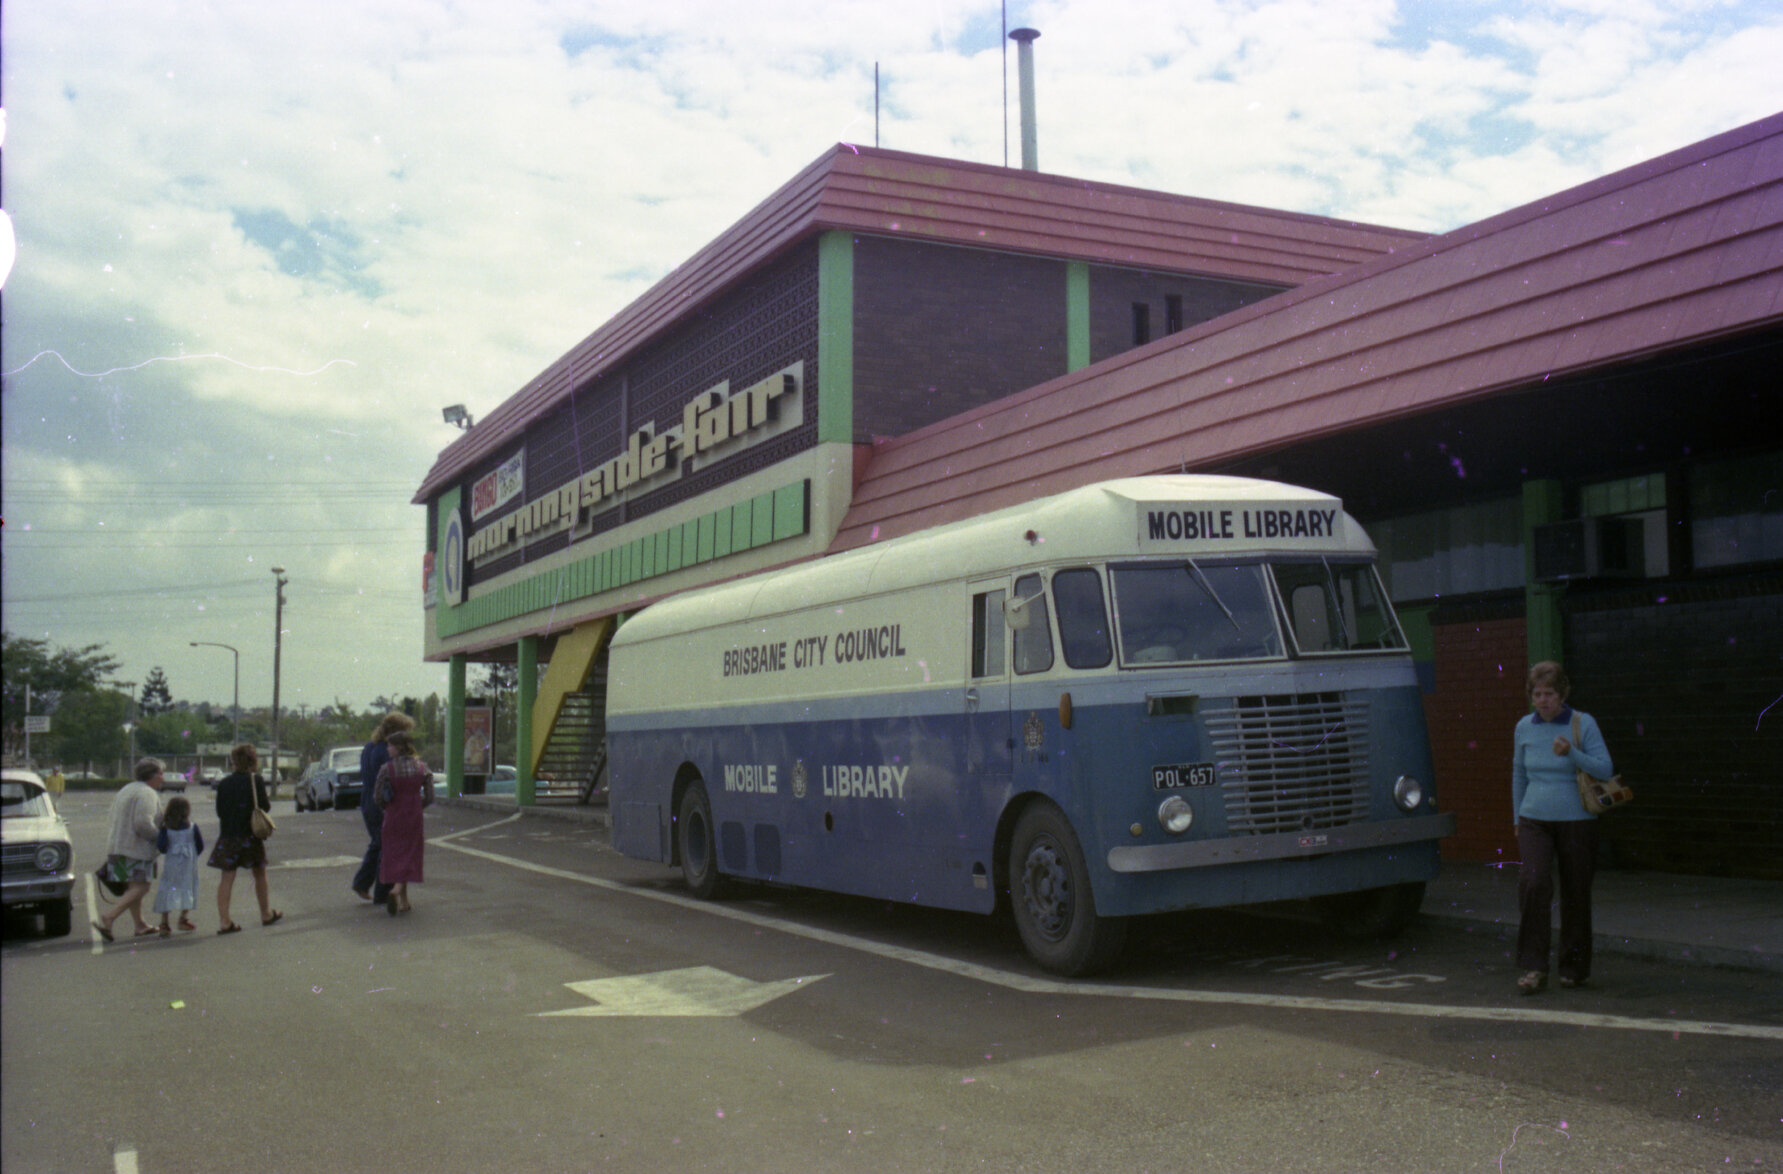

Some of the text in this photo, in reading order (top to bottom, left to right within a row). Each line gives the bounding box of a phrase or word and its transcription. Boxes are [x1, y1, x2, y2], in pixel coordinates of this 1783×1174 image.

[1148, 510, 1336, 540] MOBILE LIBRARY
[723, 624, 906, 677] BRISBANE CITY COUNCIL
[724, 764, 909, 799] MOBILE LIBRARY
